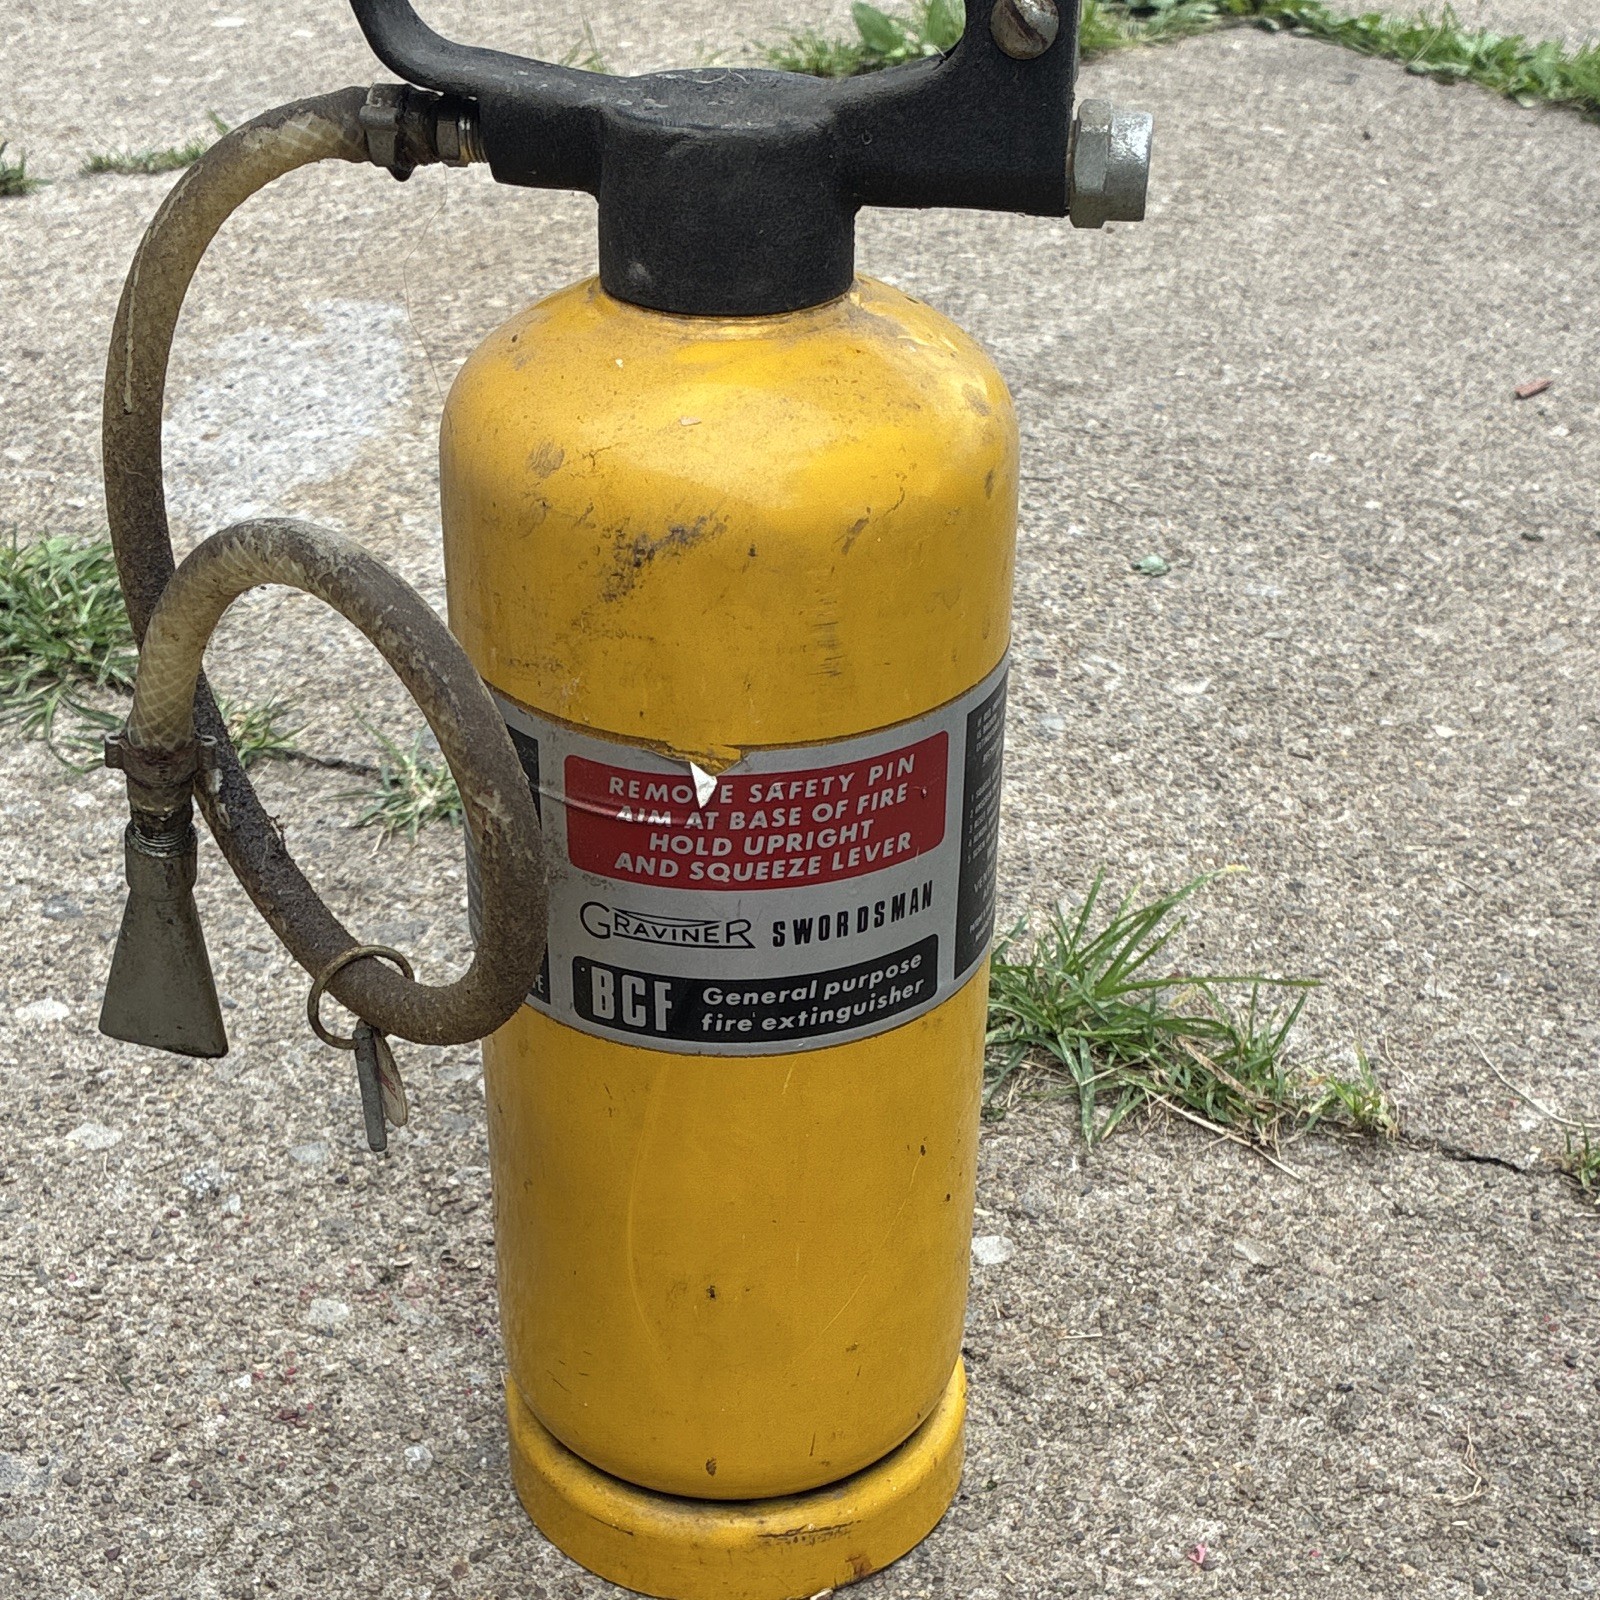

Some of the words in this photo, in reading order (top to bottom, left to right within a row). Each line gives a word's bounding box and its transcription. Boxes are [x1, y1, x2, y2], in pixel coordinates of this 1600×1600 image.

[609, 776, 733, 803] REMOE
[749, 772, 855, 803] SAFETY
[868, 753, 915, 786] PIN
[616, 805, 672, 827] AIM
[684, 811, 719, 830] AT
[729, 807, 801, 830] BASE
[811, 799, 848, 823] OF
[857, 783, 908, 815] FIRE
[614, 852, 679, 878] AND
[689, 855, 822, 883] SQUEEZE
[831, 832, 911, 871] LEVER
[650, 832, 732, 856] HOLD
[744, 819, 874, 855] UPRIGHT
[580, 901, 755, 948] GRAVINER
[772, 880, 933, 948] SWORDSMAN
[591, 966, 672, 1032] BCF
[701, 1013, 753, 1032] fire
[761, 978, 925, 1031] extinguisher
[703, 980, 818, 1006] General
[823, 954, 922, 1001] purpose
